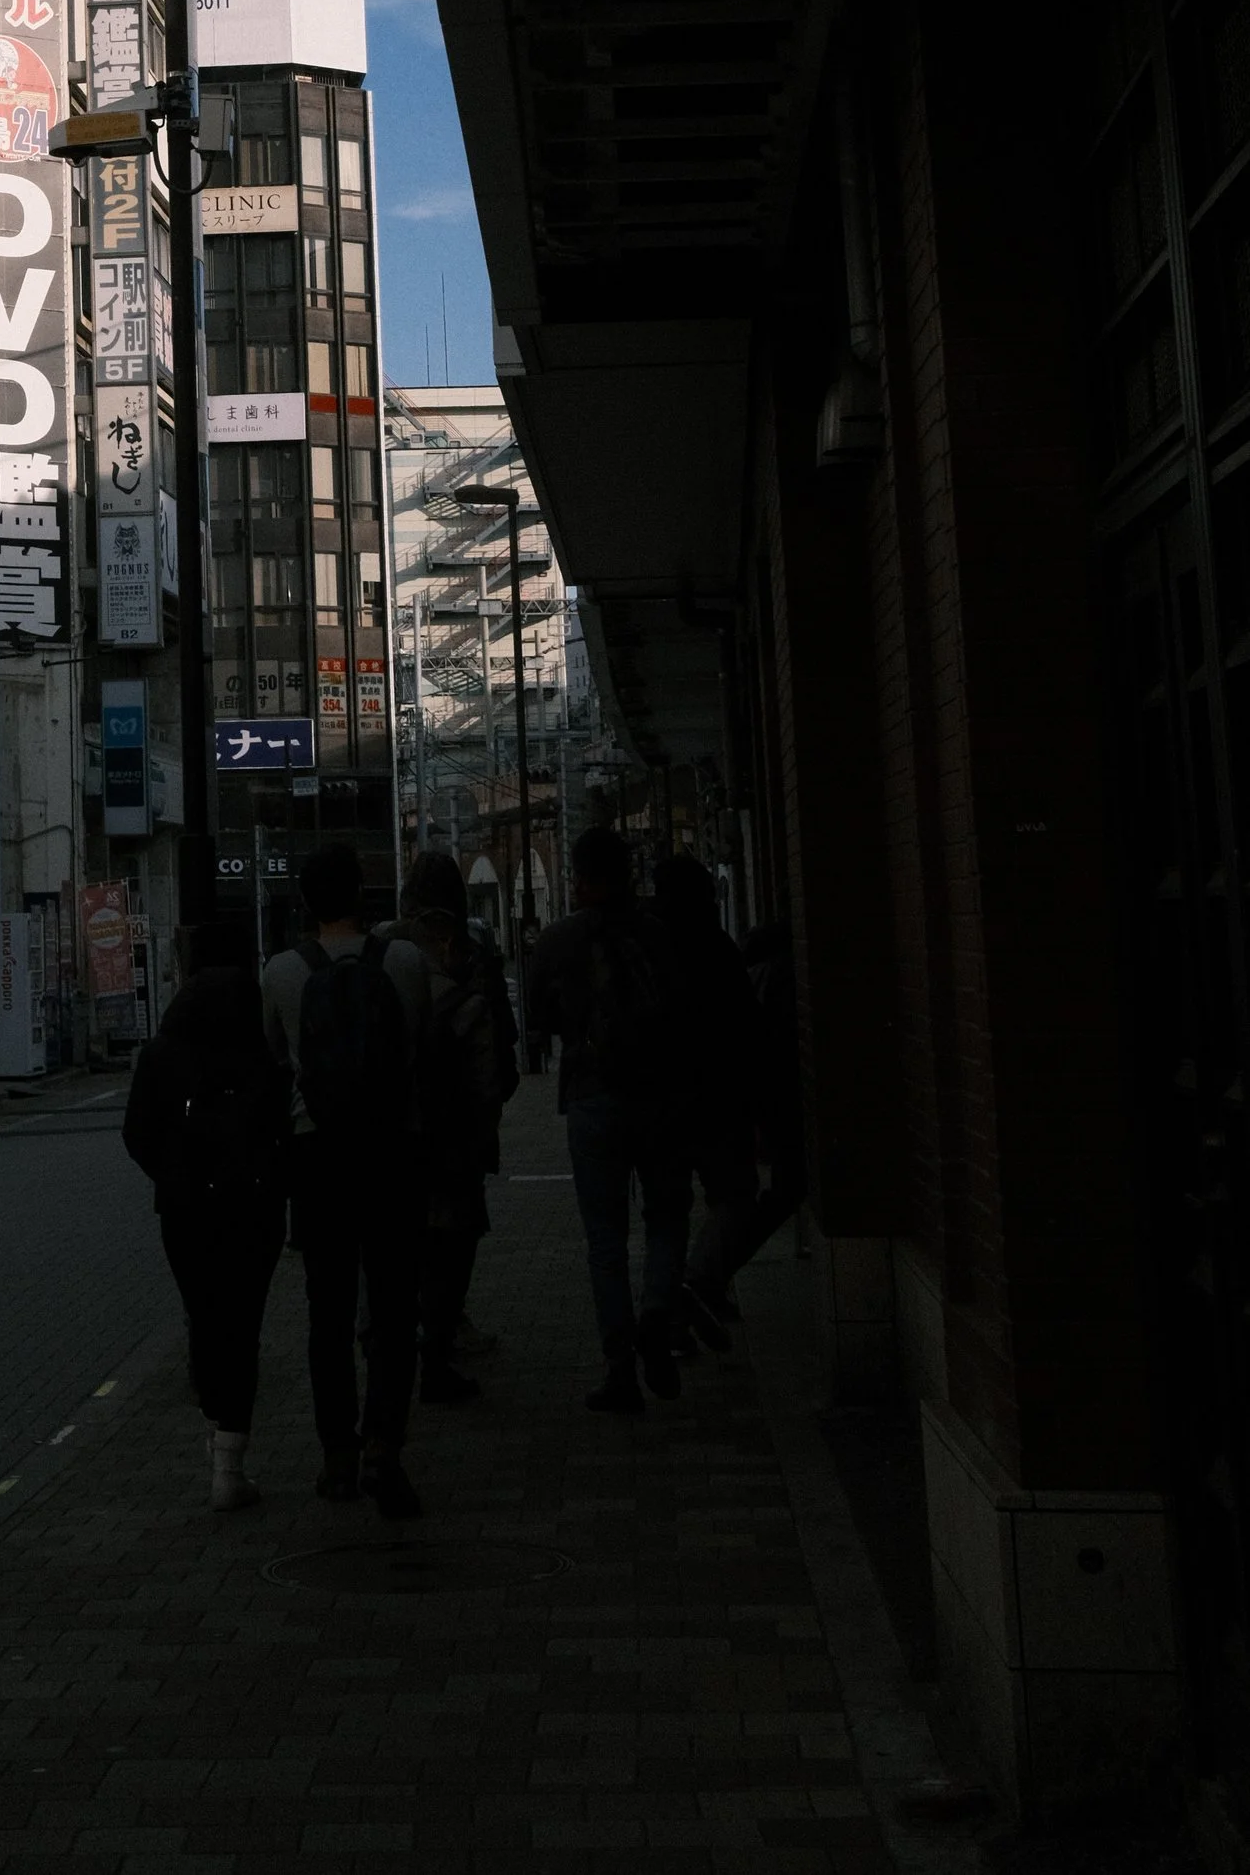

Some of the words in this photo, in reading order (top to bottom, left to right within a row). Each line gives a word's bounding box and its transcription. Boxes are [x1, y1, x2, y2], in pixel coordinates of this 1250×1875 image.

[98, 155, 142, 250] 付2F
[201, 193, 282, 212] CLINIC
[99, 263, 122, 353] コイン
[121, 262, 147, 352] 駅前
[104, 358, 144, 381] 5F
[107, 414, 144, 495] ねぎし
[120, 629, 139, 639] B2
[321, 660, 343, 671] 高校
[359, 660, 381, 672] 合格
[218, 857, 287, 873] COEE
